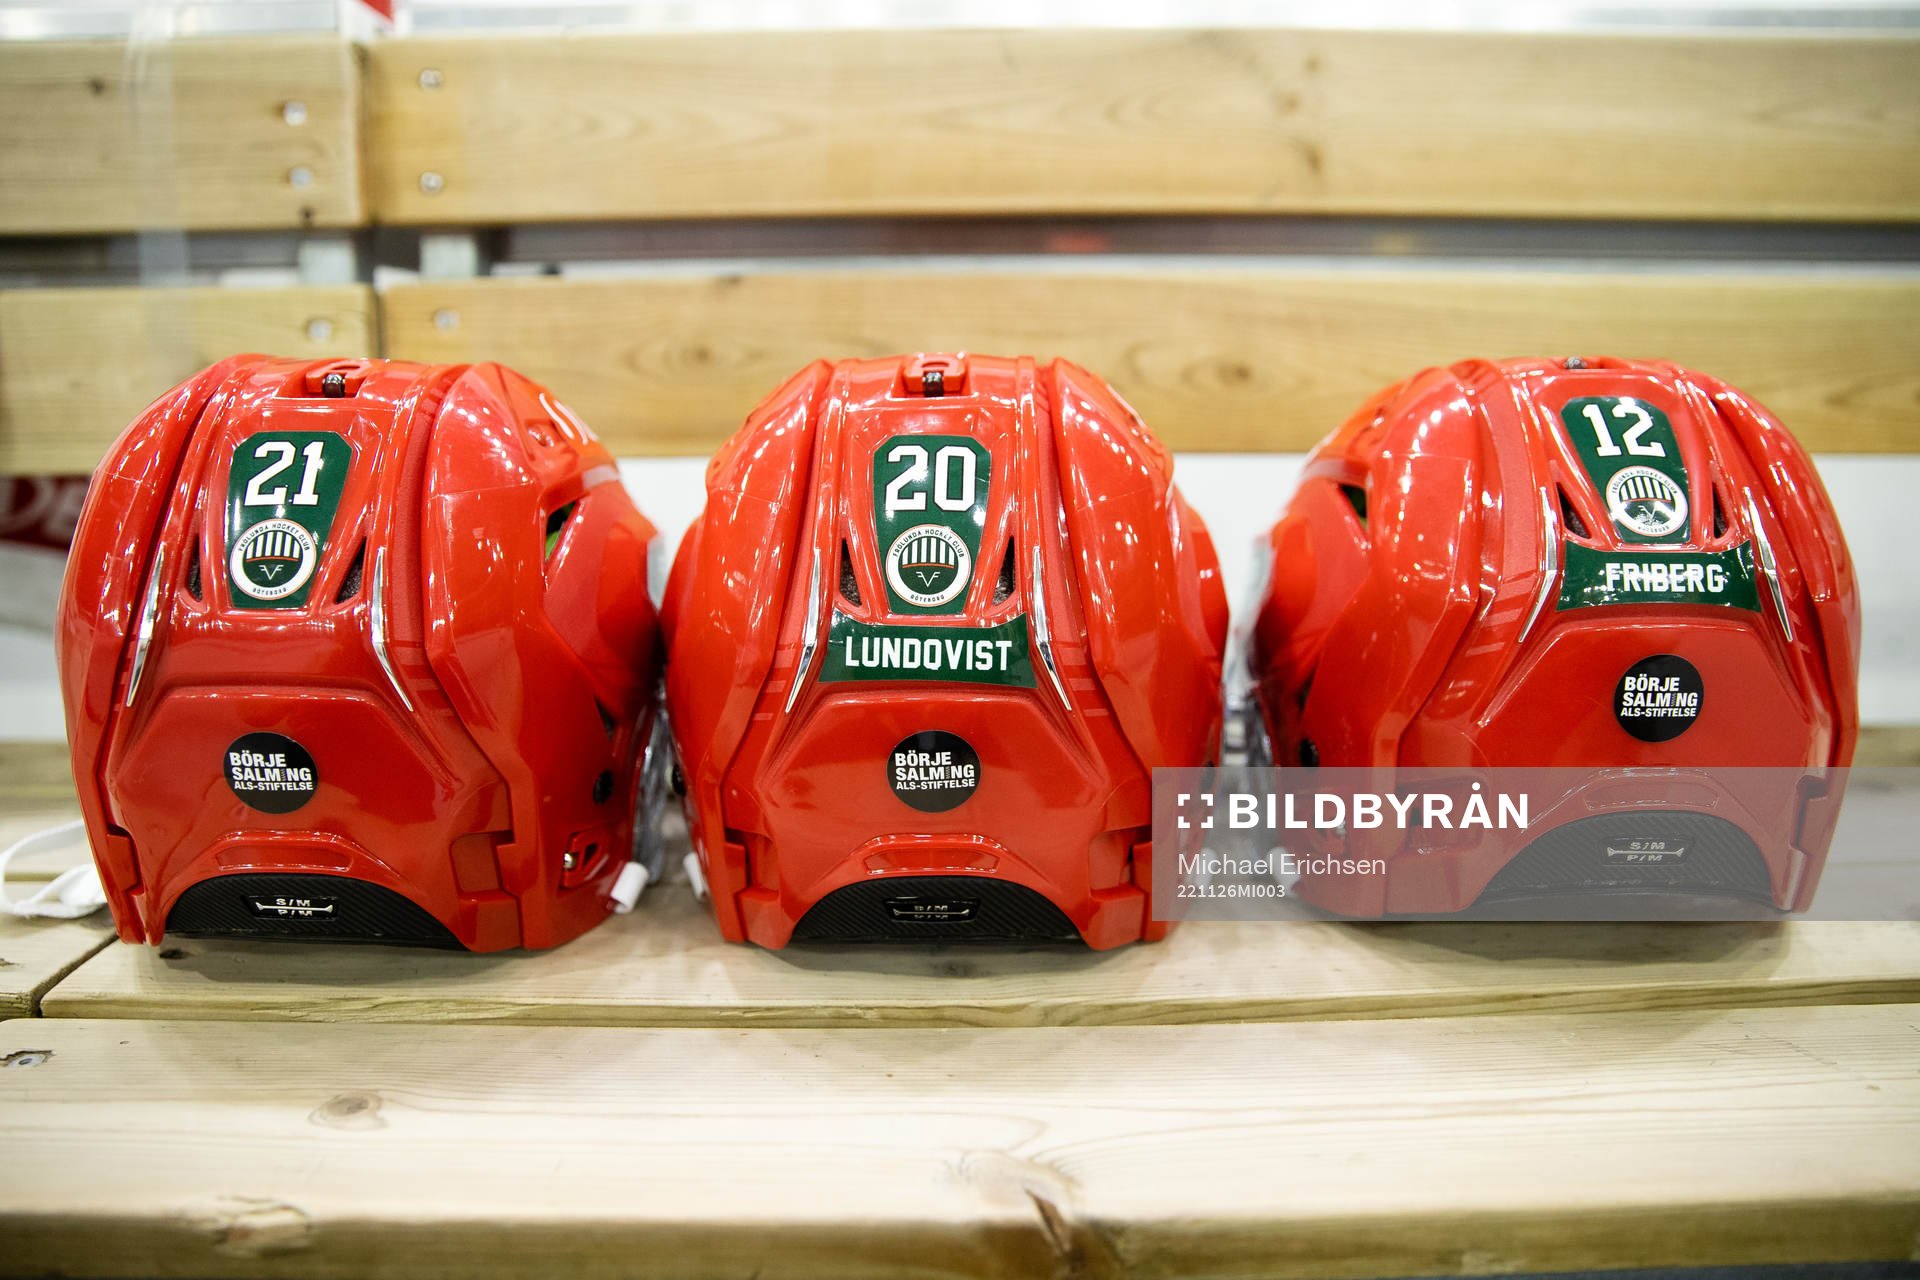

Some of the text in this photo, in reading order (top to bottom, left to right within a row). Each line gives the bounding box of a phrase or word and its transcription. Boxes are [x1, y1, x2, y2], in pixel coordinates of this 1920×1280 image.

[1582, 402, 1666, 457] 12
[244, 441, 324, 506] 21
[885, 445, 977, 512] 20
[952, 540, 965, 558] CLUB
[1605, 562, 1724, 593] FRIBERG
[845, 636, 1013, 671] LUNDQVIST
[1624, 673, 1680, 691] BÖRJE
[1620, 707, 1697, 717] ALS-STIFTELSE
[229, 750, 287, 767] BÖRJE
[894, 750, 952, 767] BÖRJE
[234, 781, 314, 791] ALS-STIFTELSE
[896, 778, 975, 790] ALS-STIFTELSE
[276, 898, 310, 906] S/M
